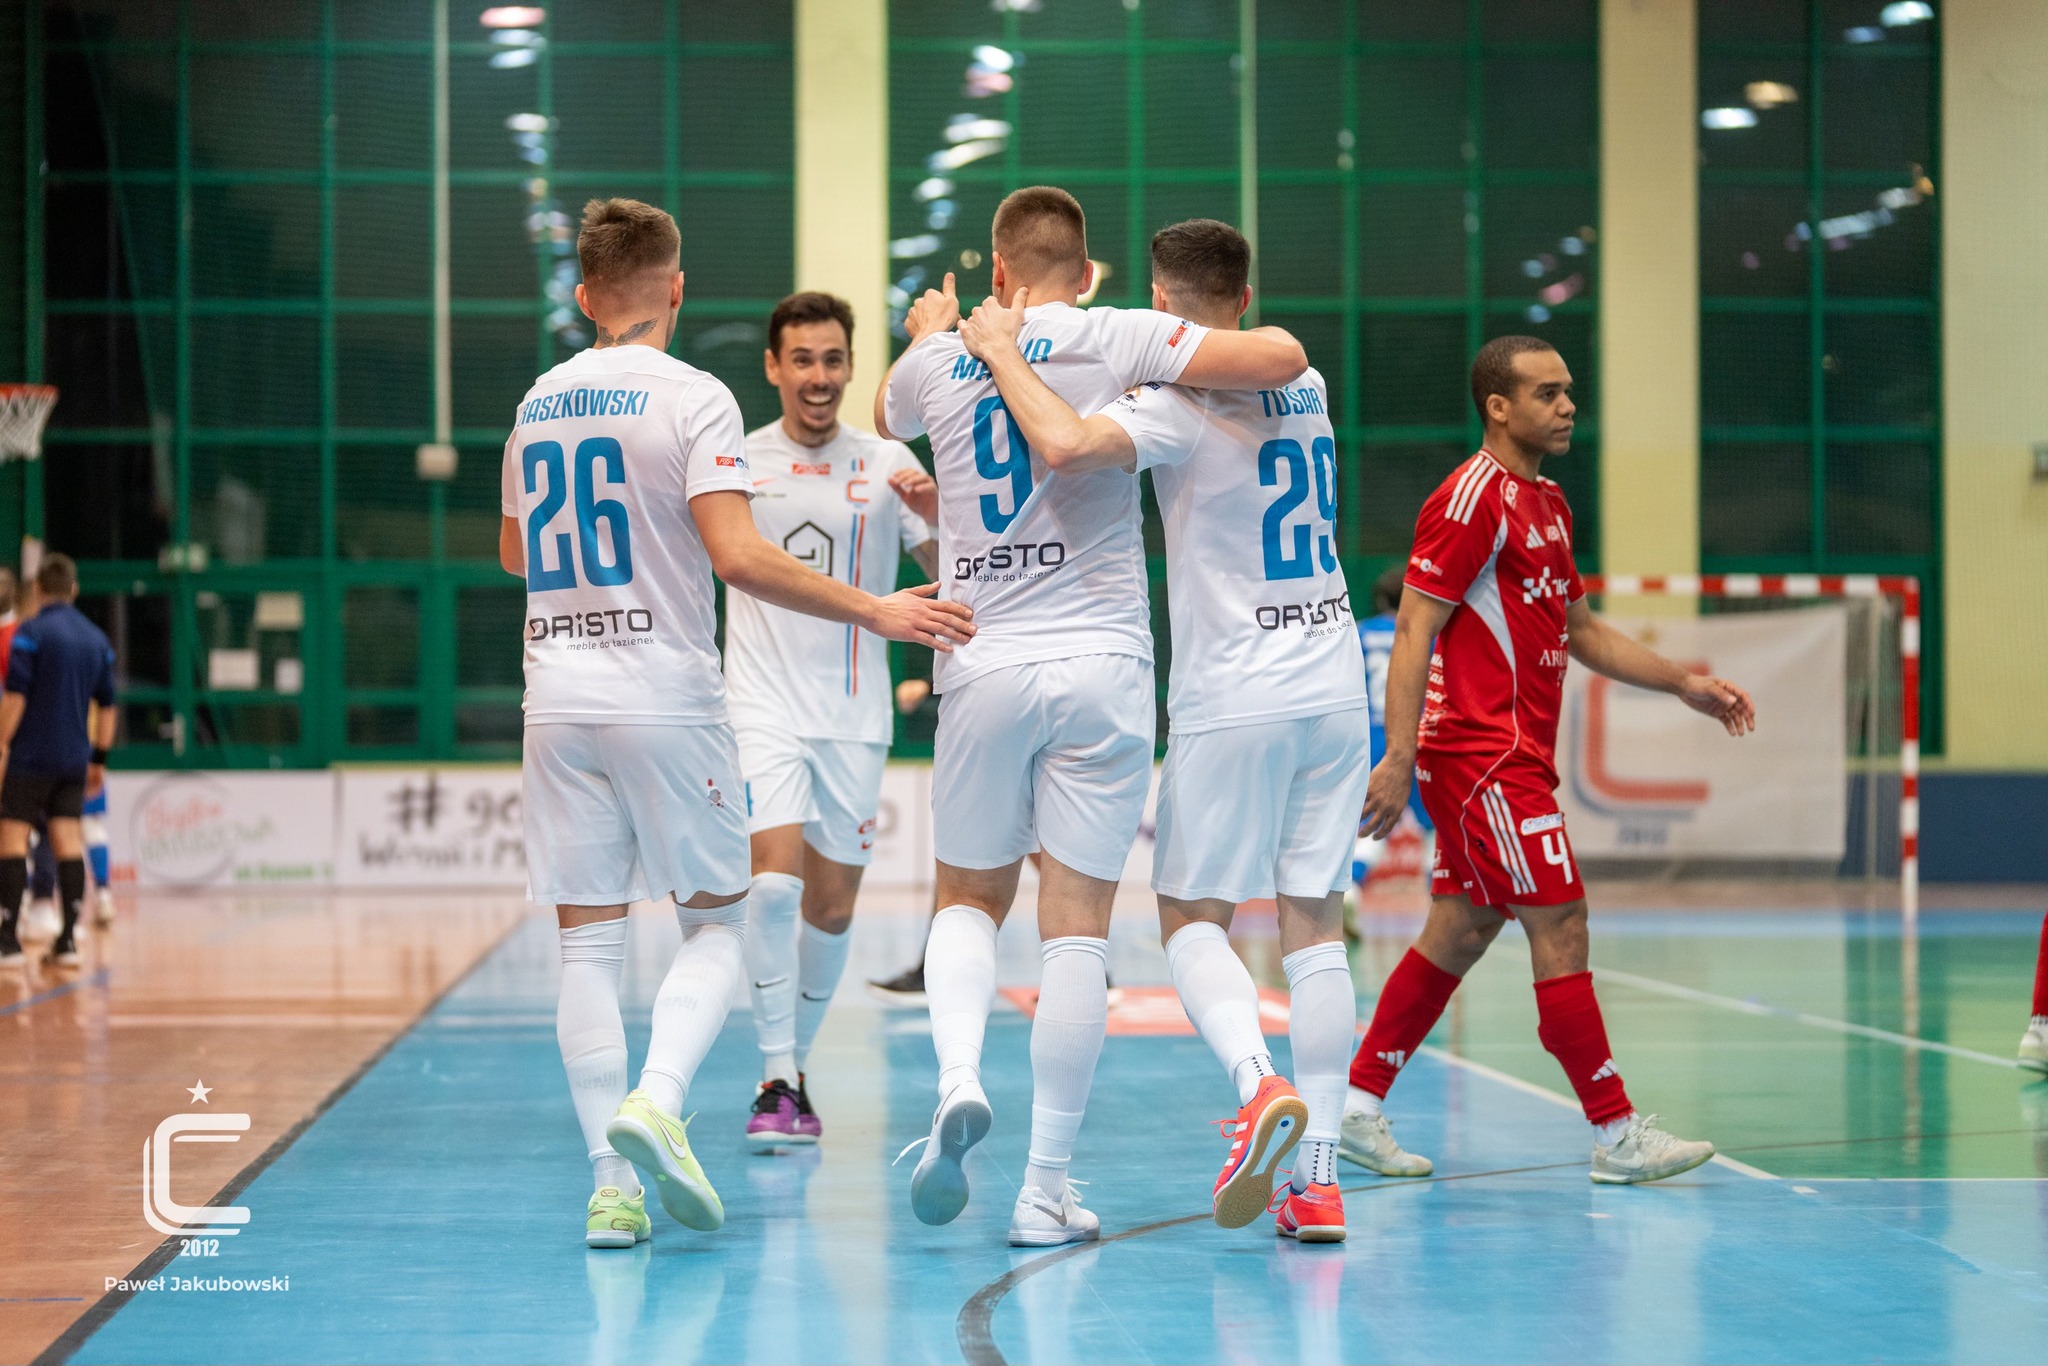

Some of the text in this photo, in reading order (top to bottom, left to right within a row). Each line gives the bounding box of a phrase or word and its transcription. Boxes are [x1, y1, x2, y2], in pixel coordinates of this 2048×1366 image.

[973, 394, 1034, 534] 9
[1258, 436, 1337, 580] 29
[522, 436, 633, 593] 26
[1002, 572, 1016, 582] do
[567, 641, 596, 650] meble
[599, 641, 610, 649] do
[1541, 831, 1574, 885] 4
